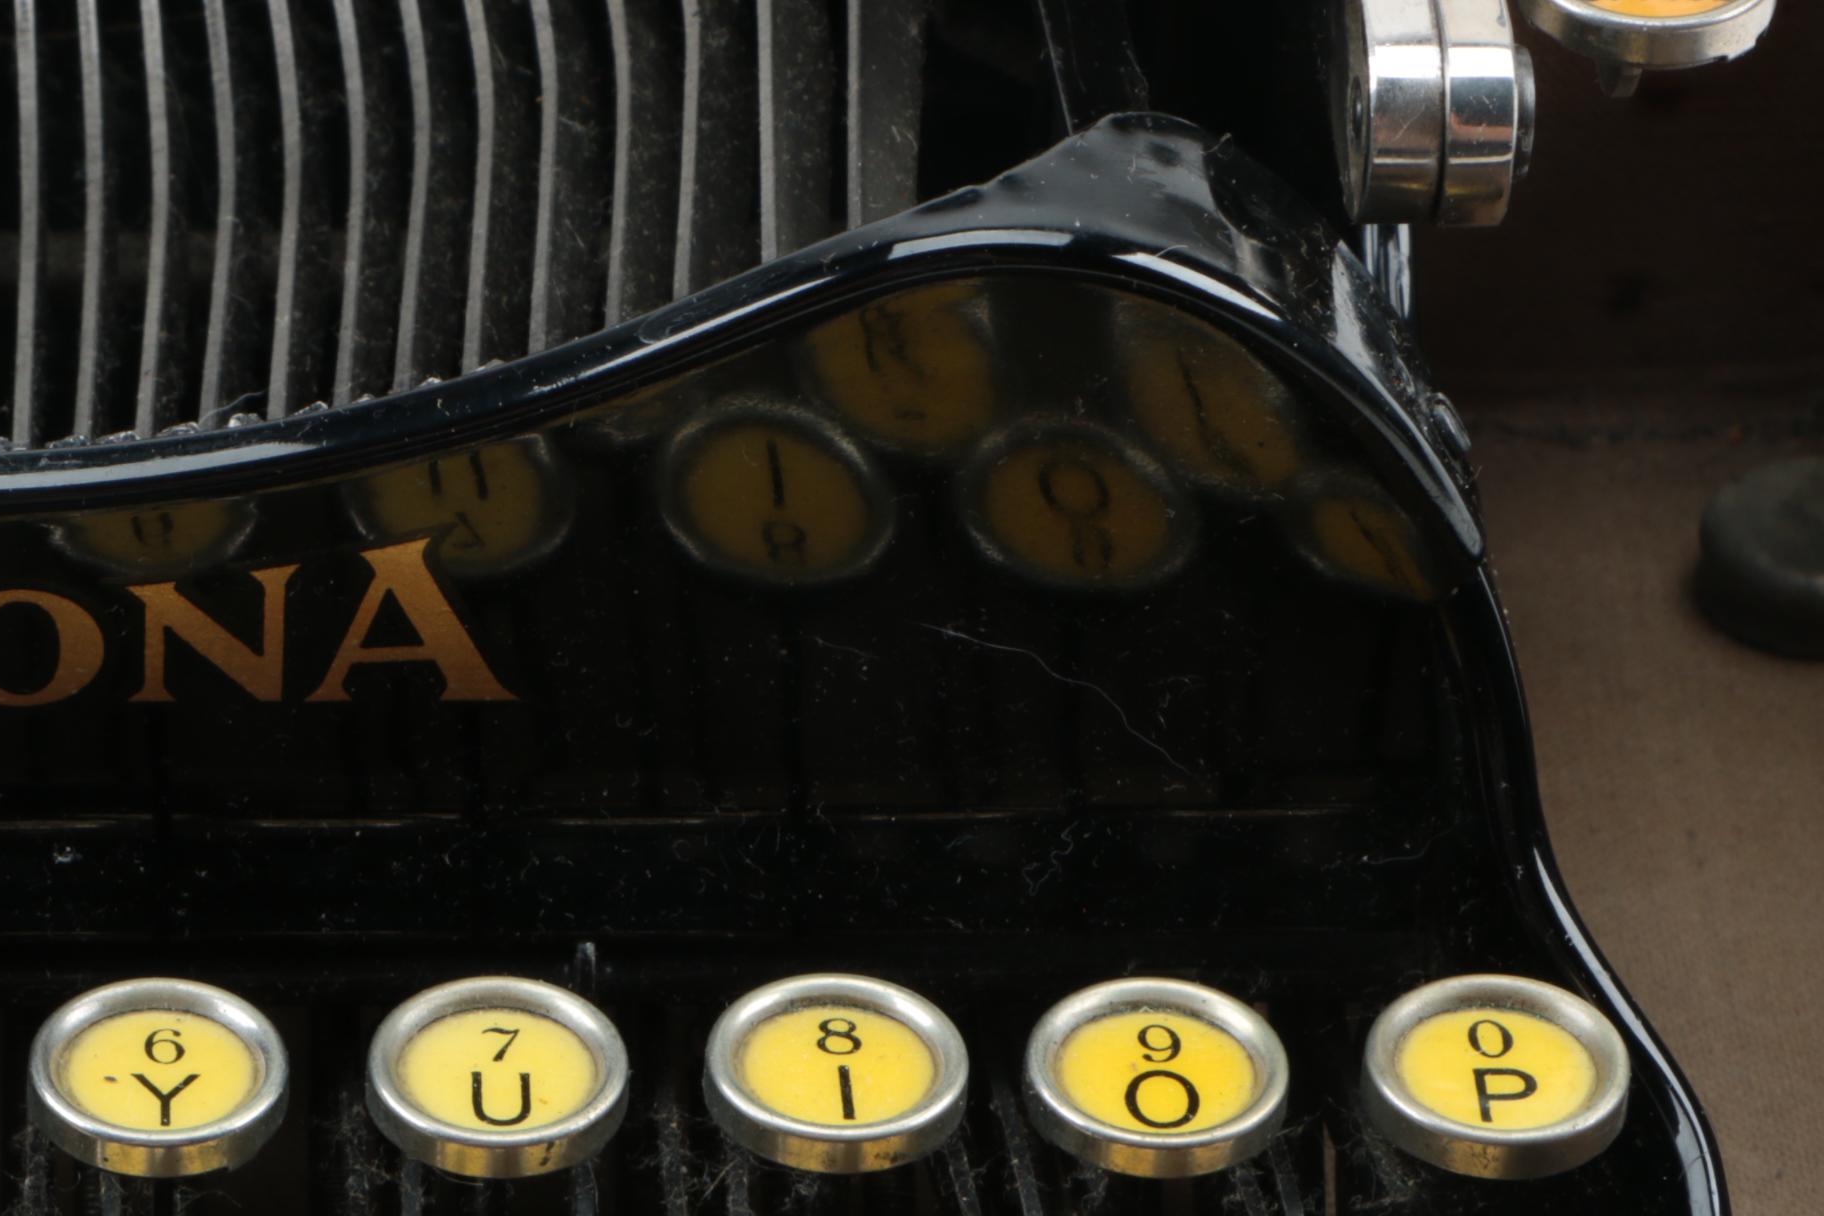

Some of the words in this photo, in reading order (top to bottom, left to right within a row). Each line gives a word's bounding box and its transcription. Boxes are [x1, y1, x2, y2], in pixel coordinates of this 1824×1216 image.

[145, 1030, 185, 1064] 6
[483, 1027, 520, 1062] 7
[816, 1018, 862, 1055] 8
[1137, 1025, 1181, 1062] 9
[133, 1074, 200, 1126] Y
[472, 1071, 531, 1126] U
[838, 1065, 856, 1120] I
[1124, 1069, 1201, 1129] O
[1473, 1068, 1537, 1122] P
